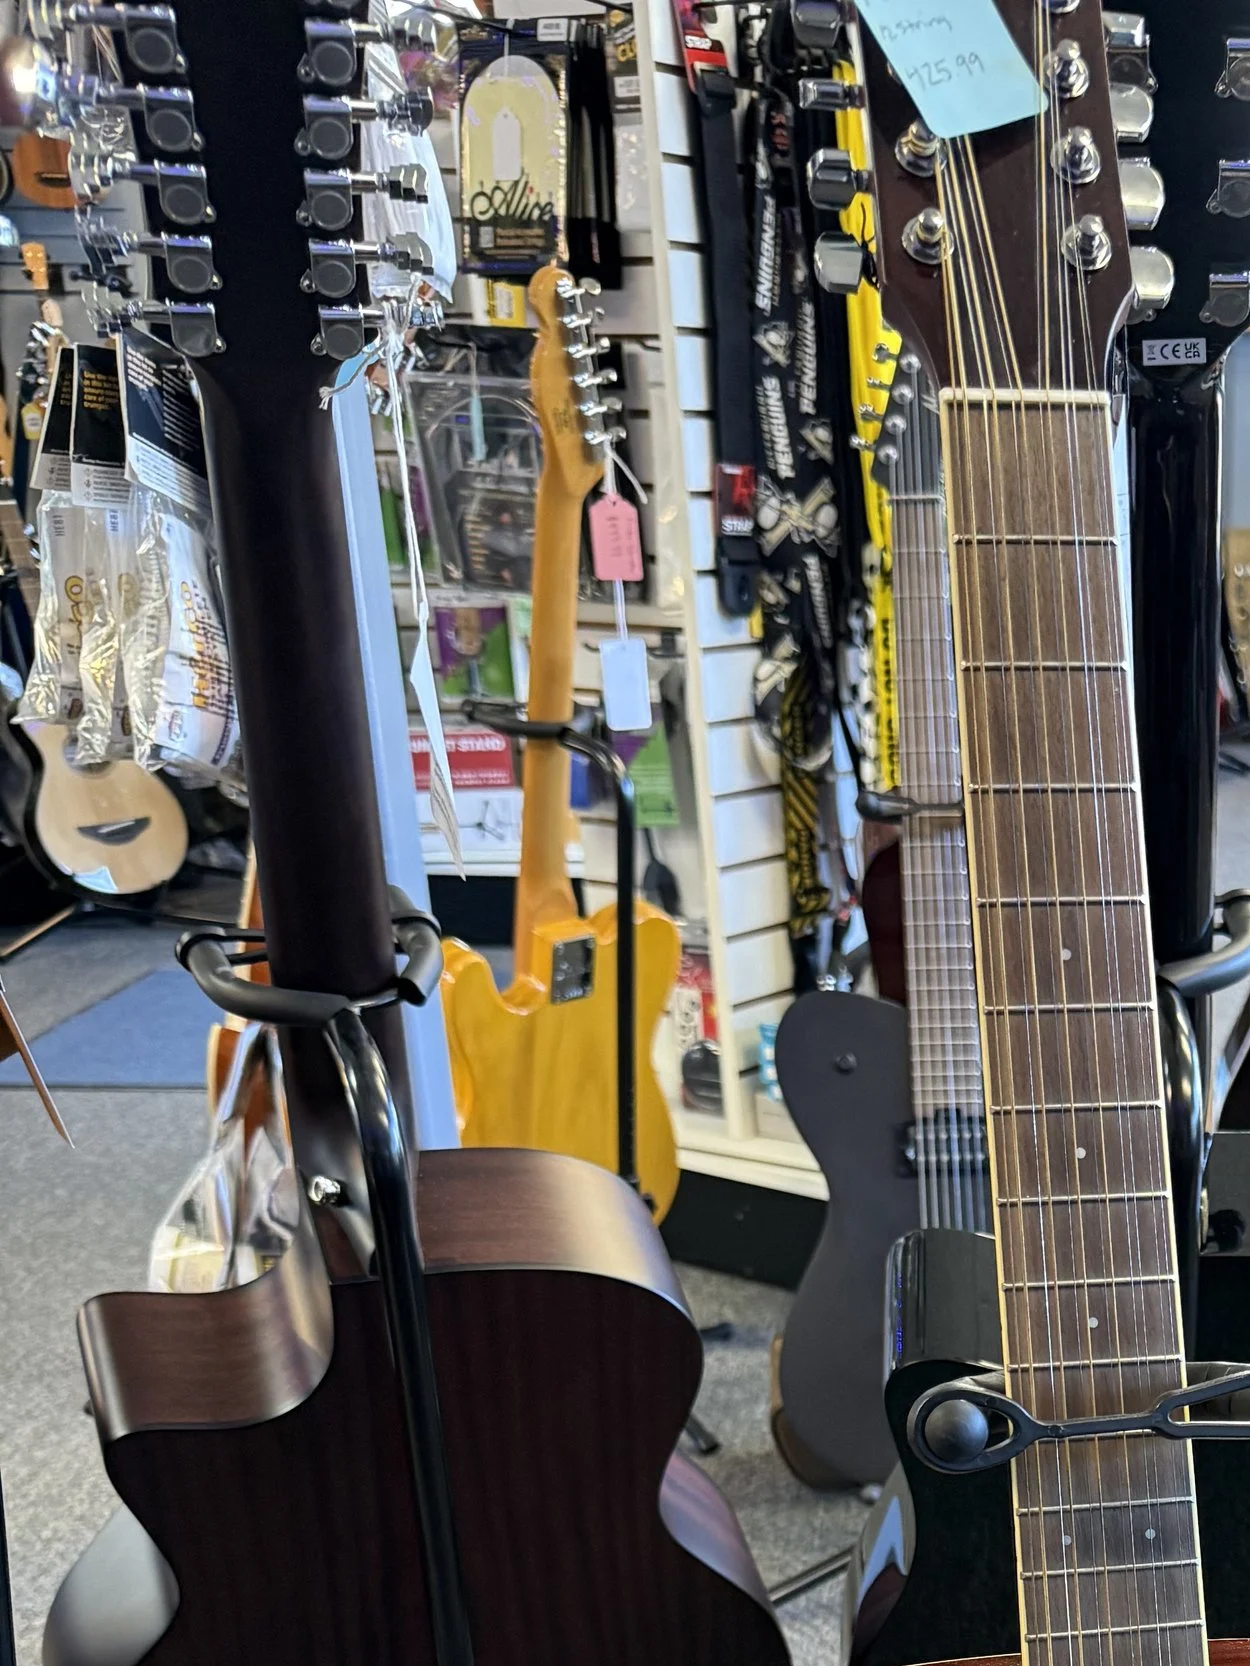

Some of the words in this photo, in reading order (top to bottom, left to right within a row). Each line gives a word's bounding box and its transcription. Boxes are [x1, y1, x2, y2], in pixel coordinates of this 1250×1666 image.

[907, 51, 985, 92] 425.99
[470, 168, 554, 222] Alice
[755, 195, 776, 317] PENGUINS
[762, 376, 796, 480] PENGUINS
